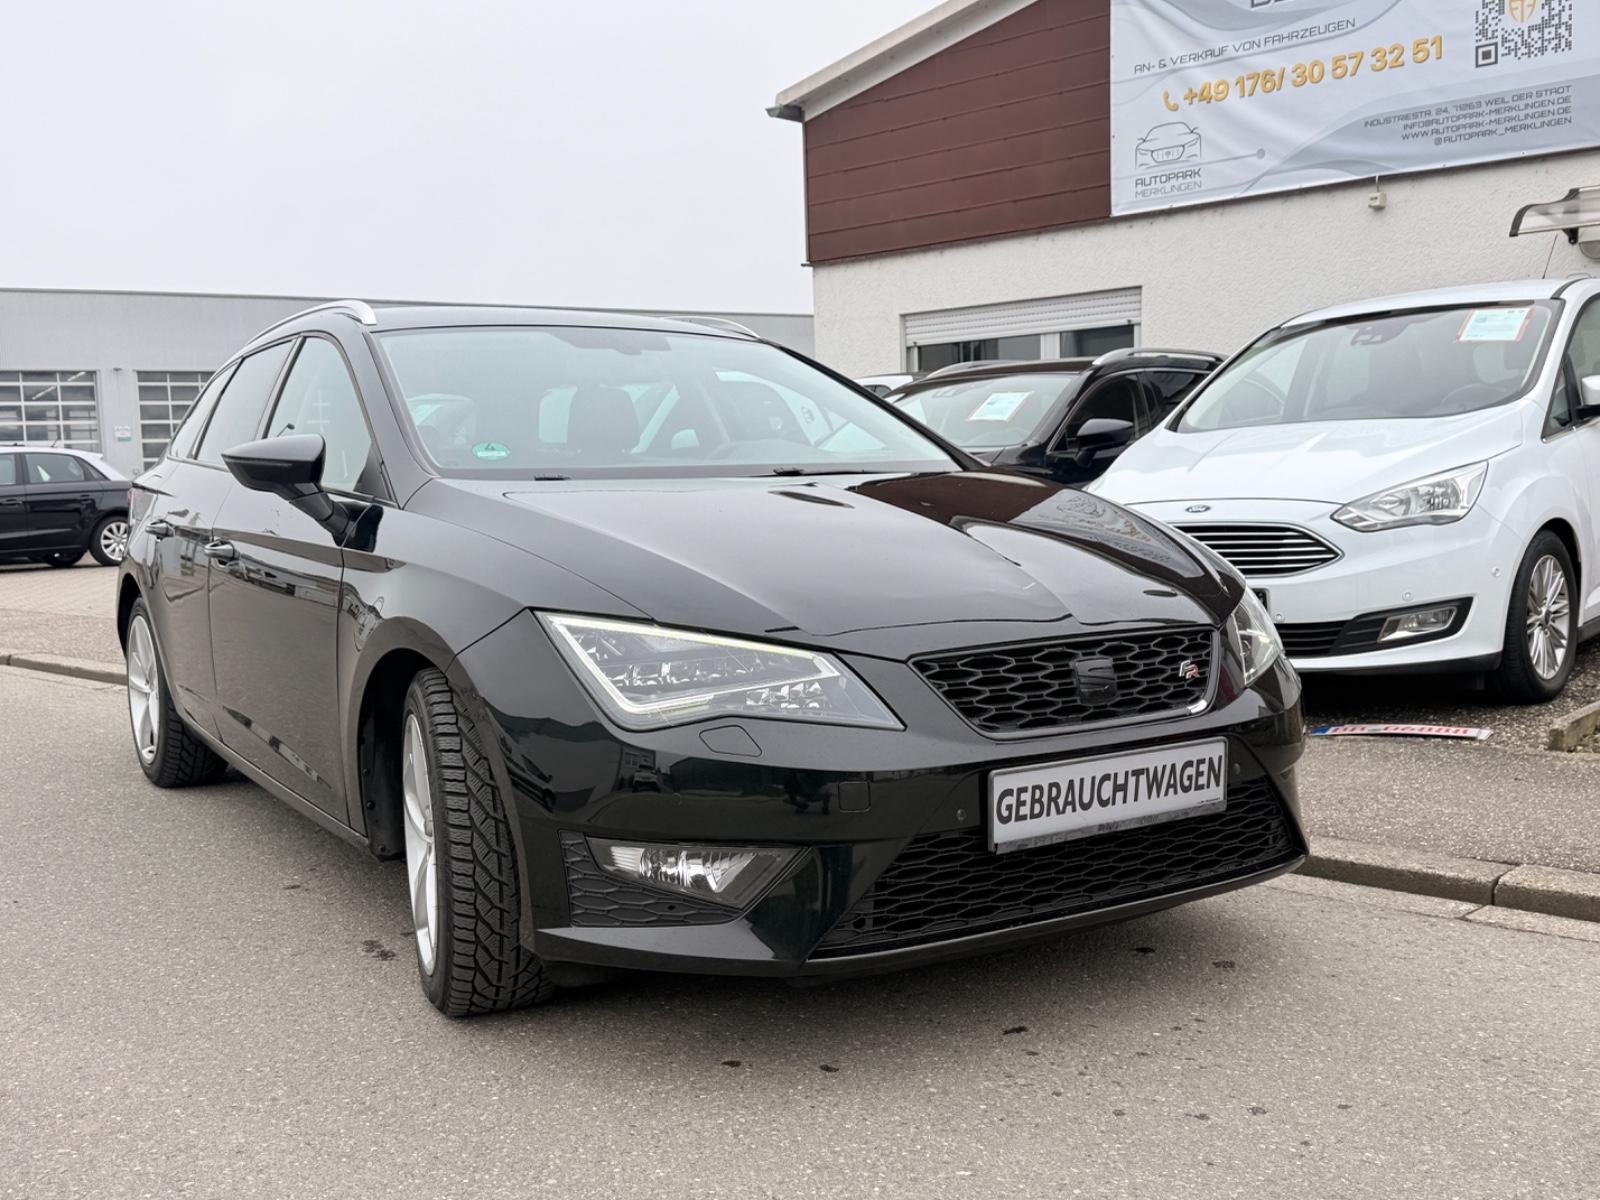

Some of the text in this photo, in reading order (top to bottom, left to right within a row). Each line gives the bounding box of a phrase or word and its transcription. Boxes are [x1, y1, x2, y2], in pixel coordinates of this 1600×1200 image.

[1134, 18, 1356, 75] AN- & VERKAUF VON FAHRZEUGEN
[1184, 35, 1443, 105] +49 176/ 30 57 32 51
[1455, 101, 1482, 113] 71263
[1485, 97, 1510, 108] WEIL
[1511, 91, 1533, 103] DER
[1535, 84, 1572, 99] STADT
[1401, 106, 1572, 141] WWW.AUTOPARK-MERKLINGEN.DE
[1135, 168, 1201, 188] AUTOPARK
[1135, 180, 1202, 198] MERKLINGEN
[1179, 660, 1200, 679] FR
[996, 755, 1223, 825] GEBRAUCHTWAGEN
